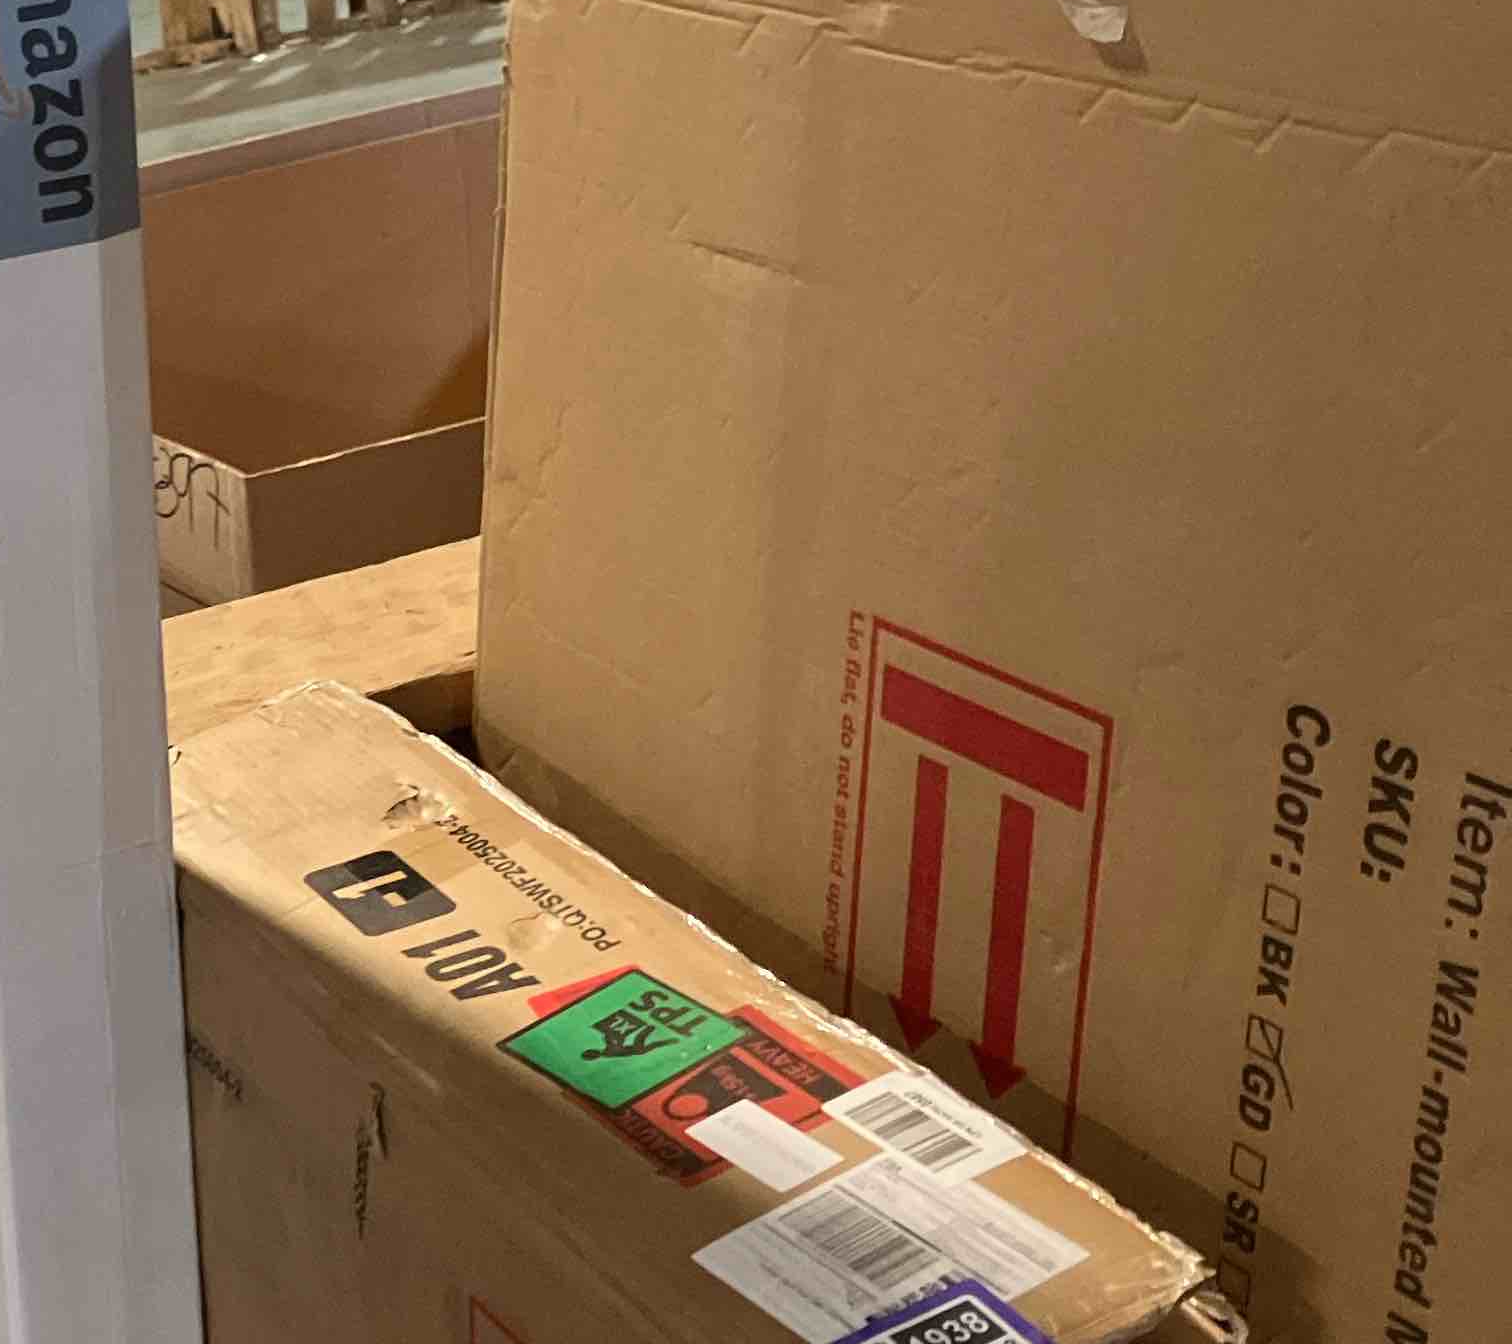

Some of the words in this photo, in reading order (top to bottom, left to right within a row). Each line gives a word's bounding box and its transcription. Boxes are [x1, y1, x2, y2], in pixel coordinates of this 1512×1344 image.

[840, 713, 855, 749] do
[837, 755, 851, 800] not
[1270, 704, 1331, 877] Color:
[1360, 737, 1420, 883] SKU:
[831, 804, 848, 878] stand
[1443, 771, 1512, 941] Item:
[400, 928, 542, 1001] A01
[823, 882, 841, 977] upright
[628, 991, 709, 1039] TPS
[743, 1039, 824, 1085] HEAVY
[1394, 959, 1480, 1309] Wall-mounted
